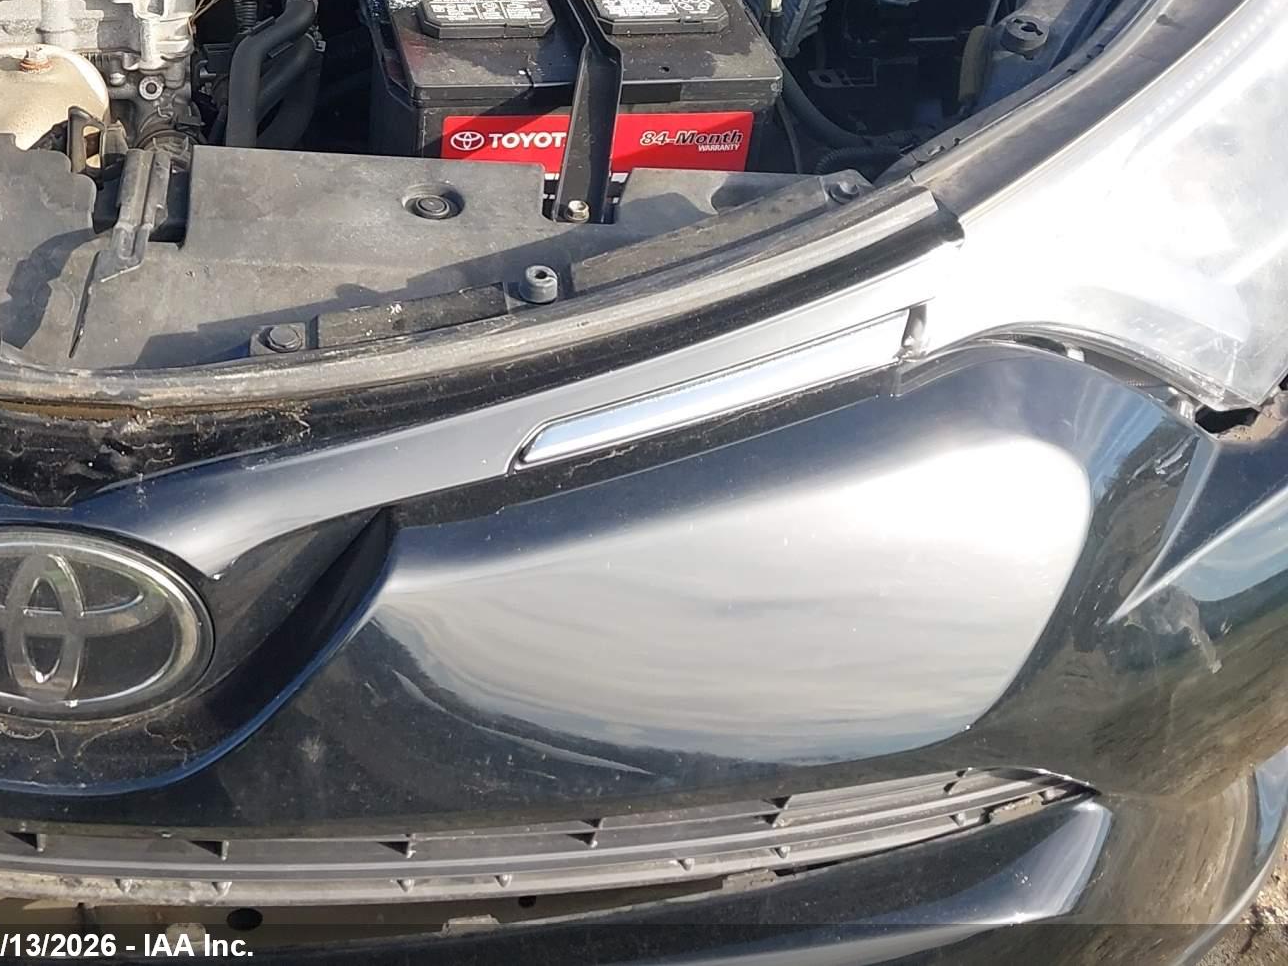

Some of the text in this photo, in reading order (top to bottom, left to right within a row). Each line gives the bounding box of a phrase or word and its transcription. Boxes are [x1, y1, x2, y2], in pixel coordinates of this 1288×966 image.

[488, 132, 566, 149] TOYOT
[639, 129, 744, 146] 84-Month
[698, 144, 740, 152] WARRANTY
